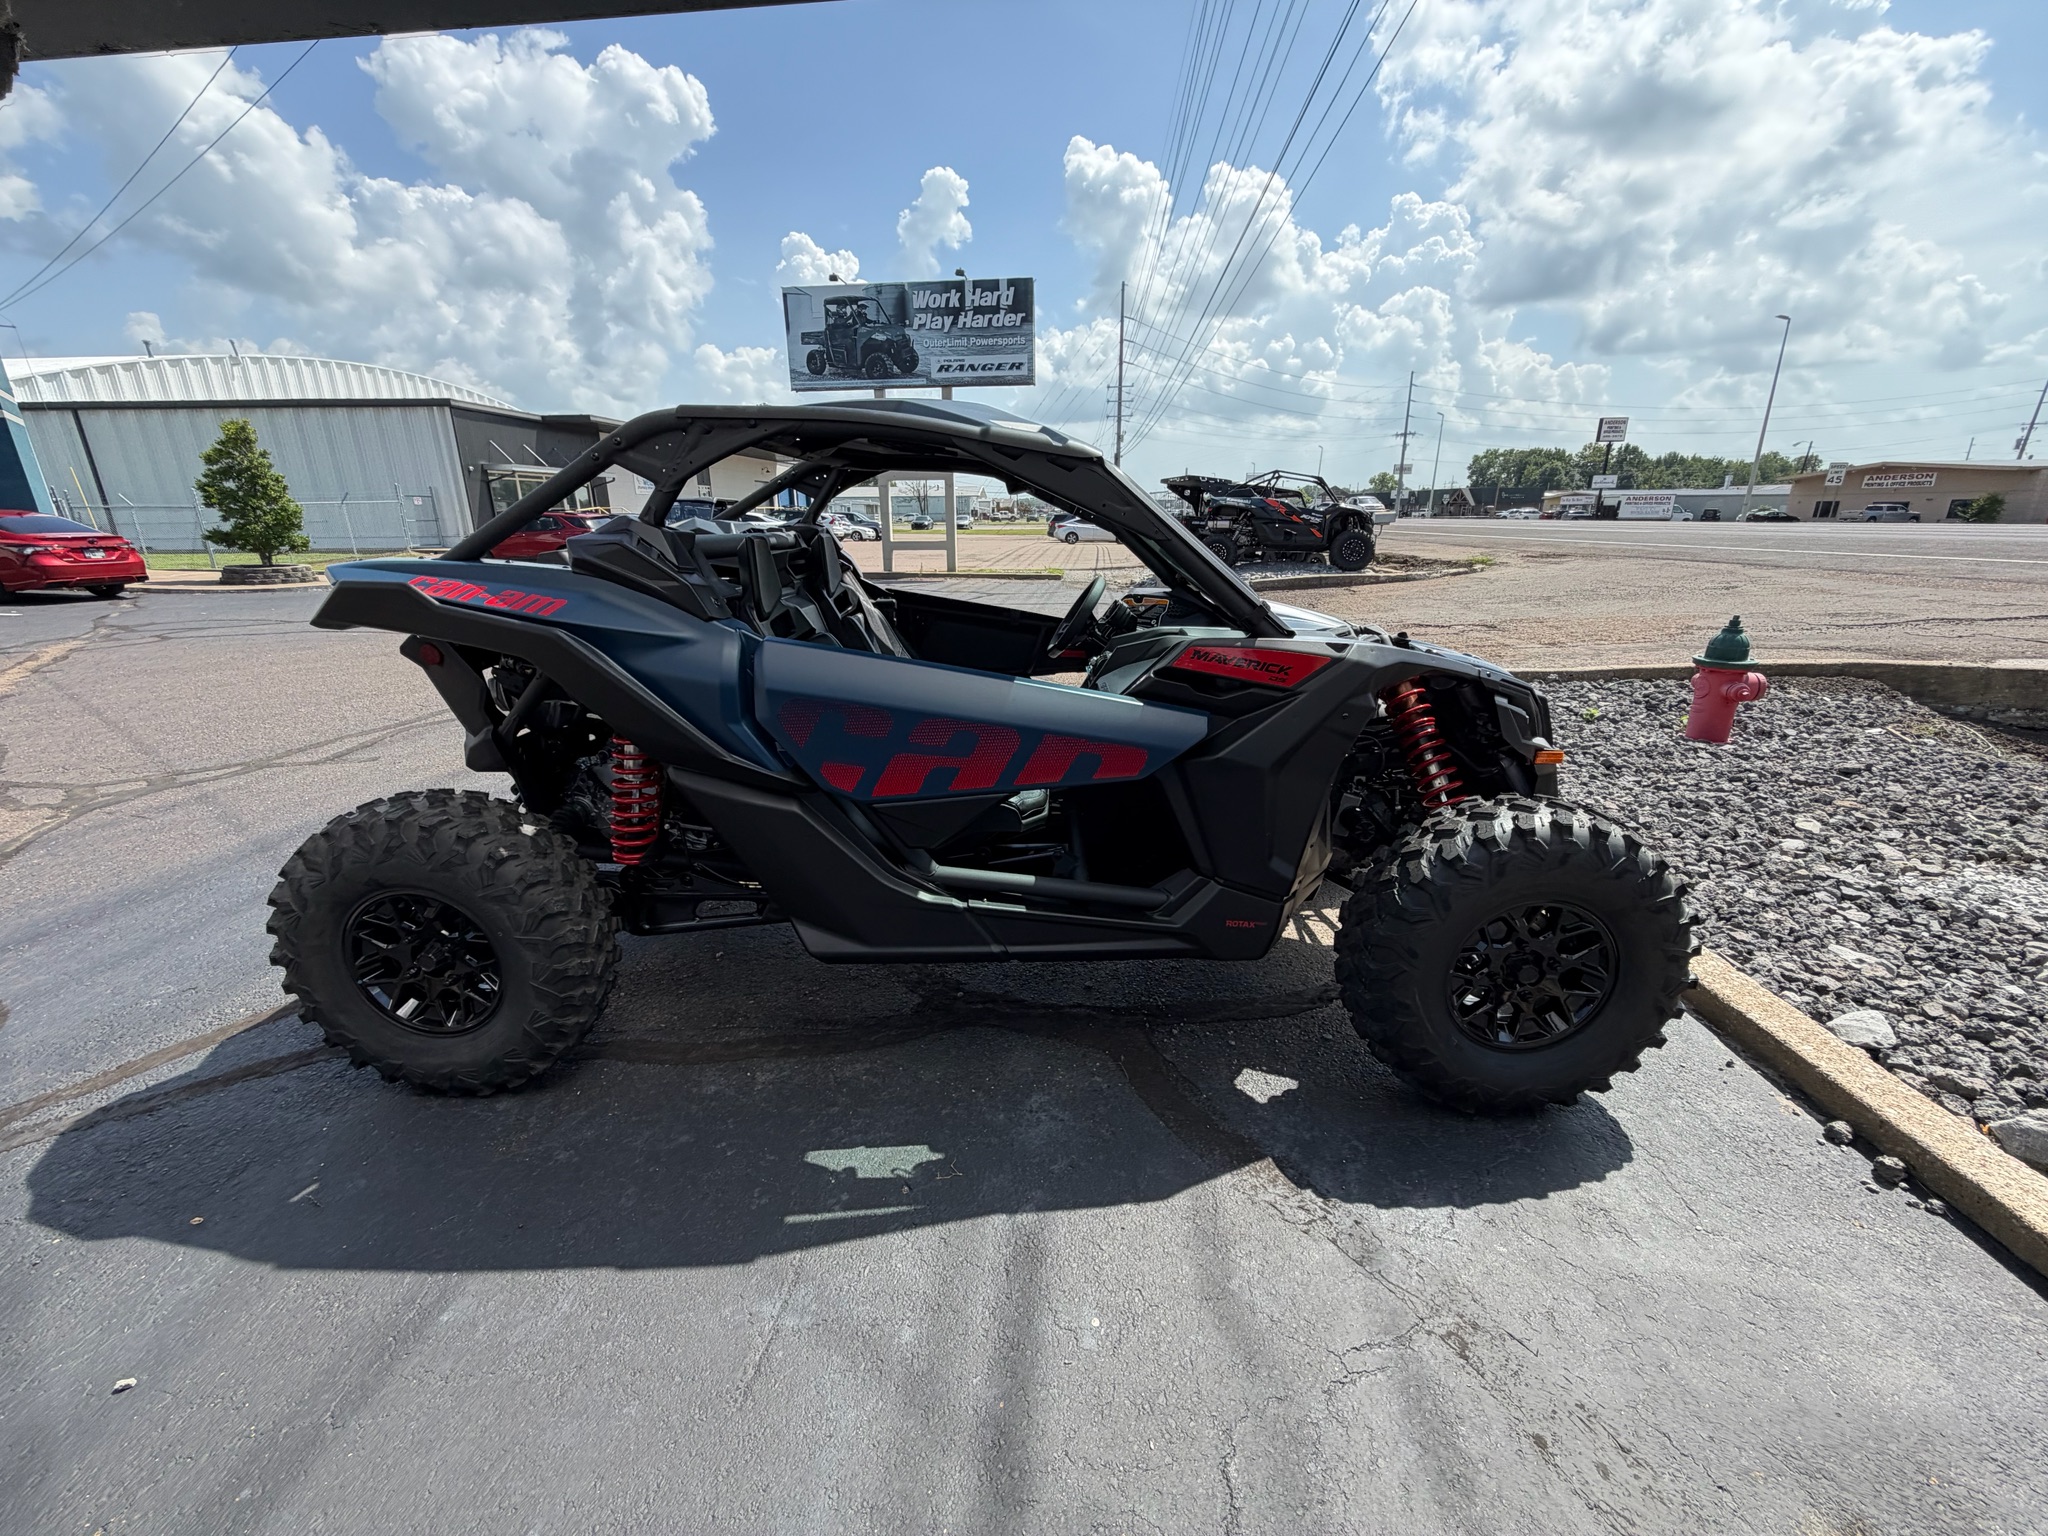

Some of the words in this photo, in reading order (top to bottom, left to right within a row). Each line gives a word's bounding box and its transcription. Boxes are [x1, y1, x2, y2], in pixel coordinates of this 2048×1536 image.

[912, 289, 961, 309] Work
[965, 286, 1015, 307] Hard
[912, 312, 955, 333] Play
[957, 310, 1026, 329] Harder
[969, 335, 1026, 347] Powersports
[936, 361, 1025, 373] RANGER
[1827, 475, 1843, 484] 45
[1866, 473, 1935, 481] ANDERSON
[408, 575, 568, 616] can-am
[1190, 649, 1293, 676] MAVERICK
[1225, 920, 1256, 928] ROTAX
